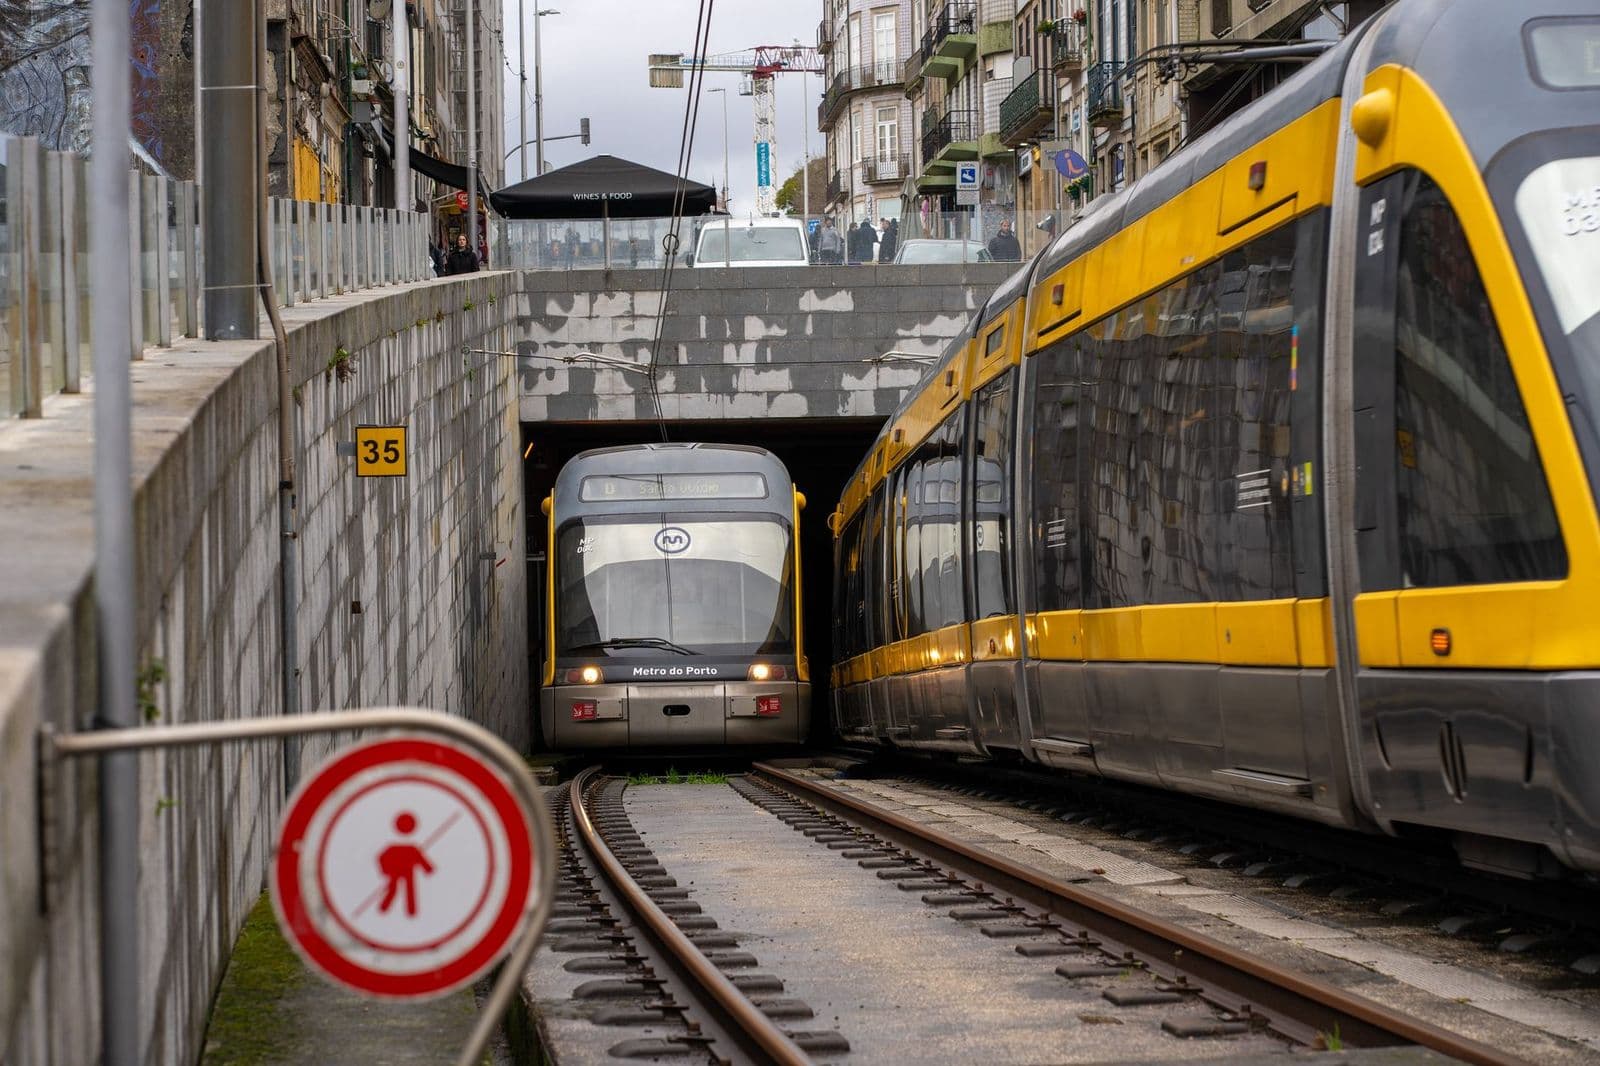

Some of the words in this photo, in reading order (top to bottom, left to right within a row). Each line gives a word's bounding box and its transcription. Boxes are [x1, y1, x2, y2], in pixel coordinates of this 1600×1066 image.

[573, 192, 599, 200] WINES
[362, 439, 400, 464] 35
[633, 667, 667, 676] Metro
[669, 667, 683, 675] do
[686, 666, 718, 675] Porto
